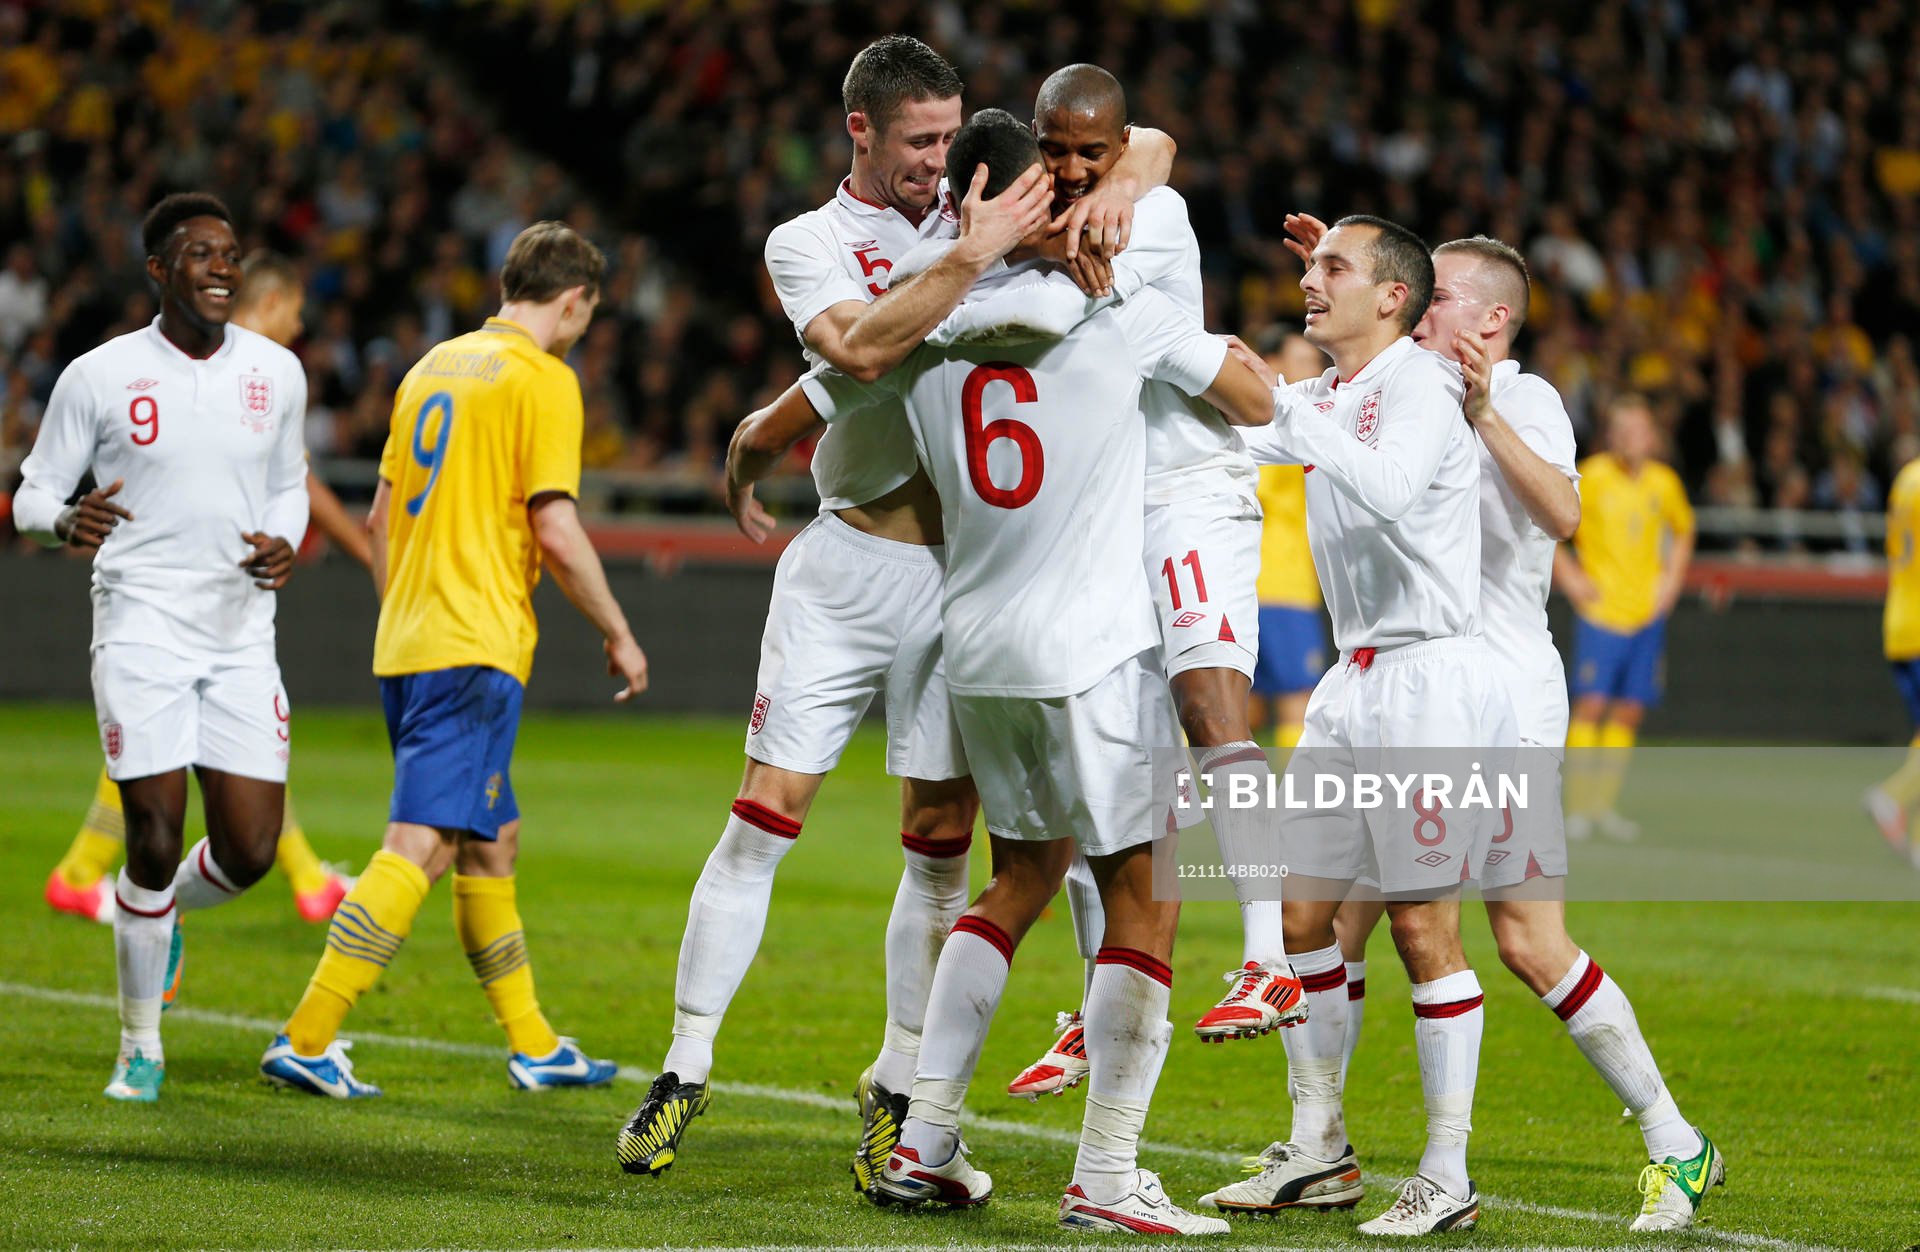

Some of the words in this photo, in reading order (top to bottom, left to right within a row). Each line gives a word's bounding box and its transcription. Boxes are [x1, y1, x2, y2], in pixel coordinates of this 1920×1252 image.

[853, 247, 893, 297] 5
[129, 396, 160, 446] 9
[961, 361, 1045, 509] 6
[406, 390, 453, 516] 9
[1161, 550, 1209, 611] 11
[1412, 786, 1447, 847] 8
[1133, 1209, 1159, 1221] KING
